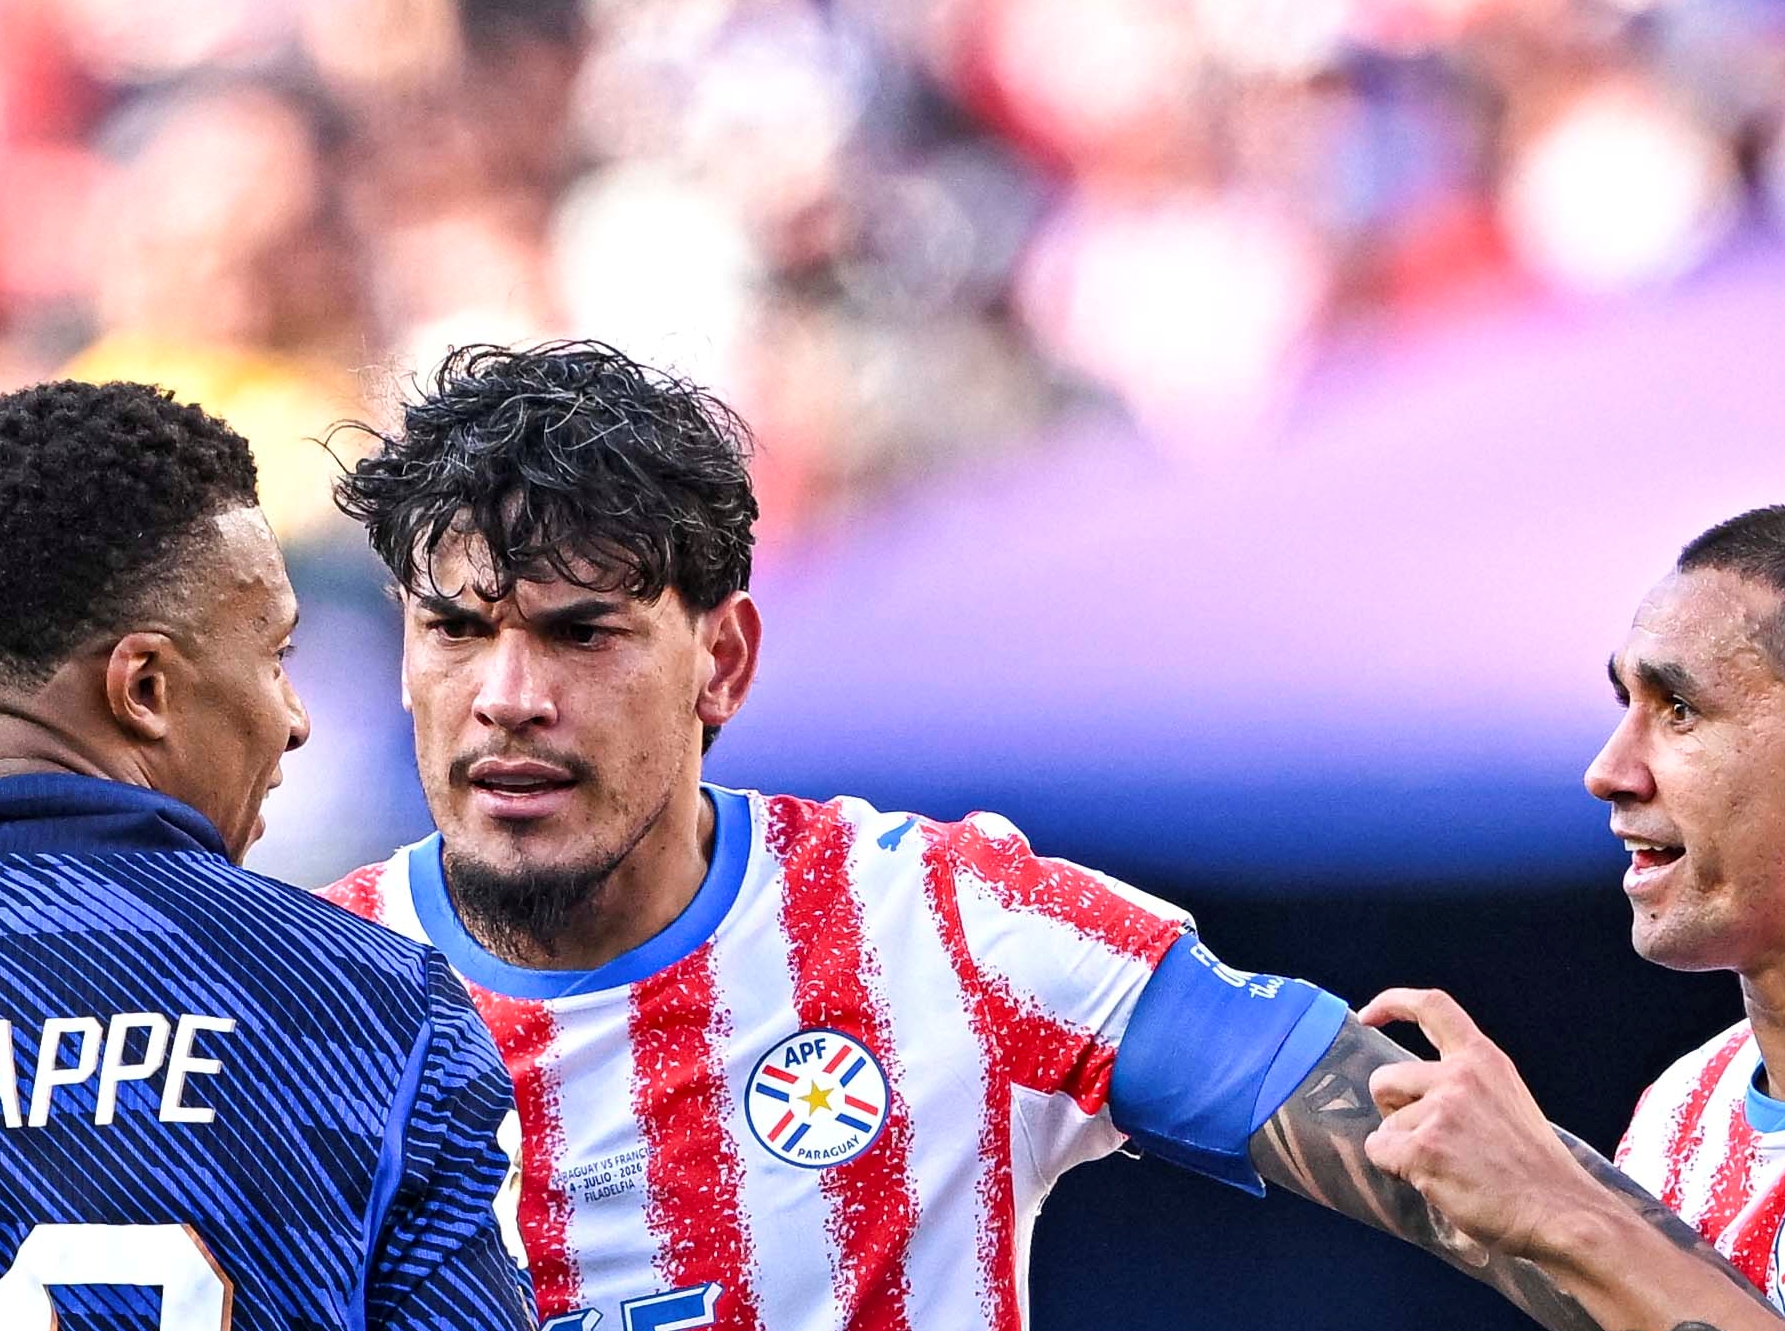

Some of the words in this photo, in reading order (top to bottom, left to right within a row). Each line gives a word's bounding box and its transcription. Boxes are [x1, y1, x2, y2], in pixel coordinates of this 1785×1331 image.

[784, 1037, 827, 1069] APF
[796, 1133, 860, 1160] PARAGUAY
[583, 1172, 612, 1190] JULIO
[619, 1162, 643, 1179] 2026
[599, 1158, 614, 1171] VS
[584, 1178, 636, 1203] FILADELFIA
